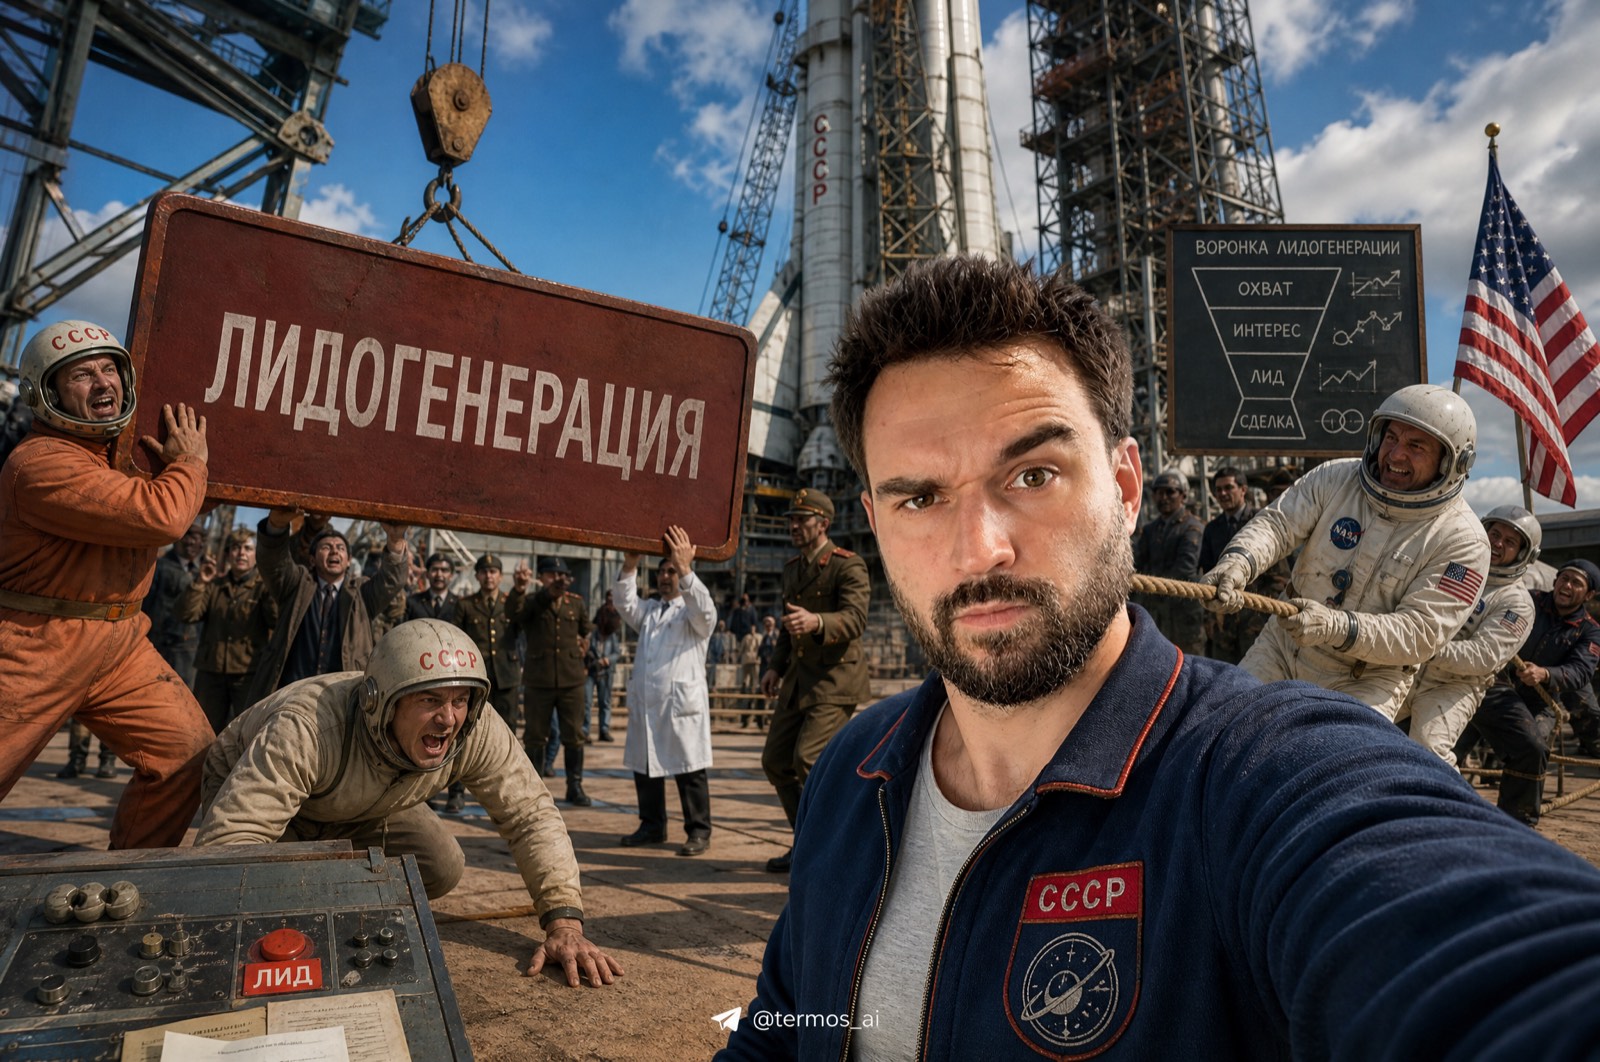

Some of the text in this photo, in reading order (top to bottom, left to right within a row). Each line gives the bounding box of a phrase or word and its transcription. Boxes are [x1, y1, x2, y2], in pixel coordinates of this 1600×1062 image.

[813, 114, 828, 206] СССР
[1195, 239, 1401, 257] ВОРОНКА ЛИДОГЕНЕРАЦИИ
[1237, 281, 1294, 297] ОХВАТ
[51, 327, 110, 351] СССР
[1233, 323, 1302, 338] ИНТЕРЕС
[1250, 369, 1285, 387] ЛИД
[203, 311, 706, 482] ЛИДОГЕНЕРАЦИЯ
[1239, 414, 1295, 431] СДЕЛКА
[1333, 524, 1358, 544] NASA
[419, 649, 477, 671] СССР
[1038, 877, 1126, 912] СССР
[253, 965, 314, 988] ЛИД
